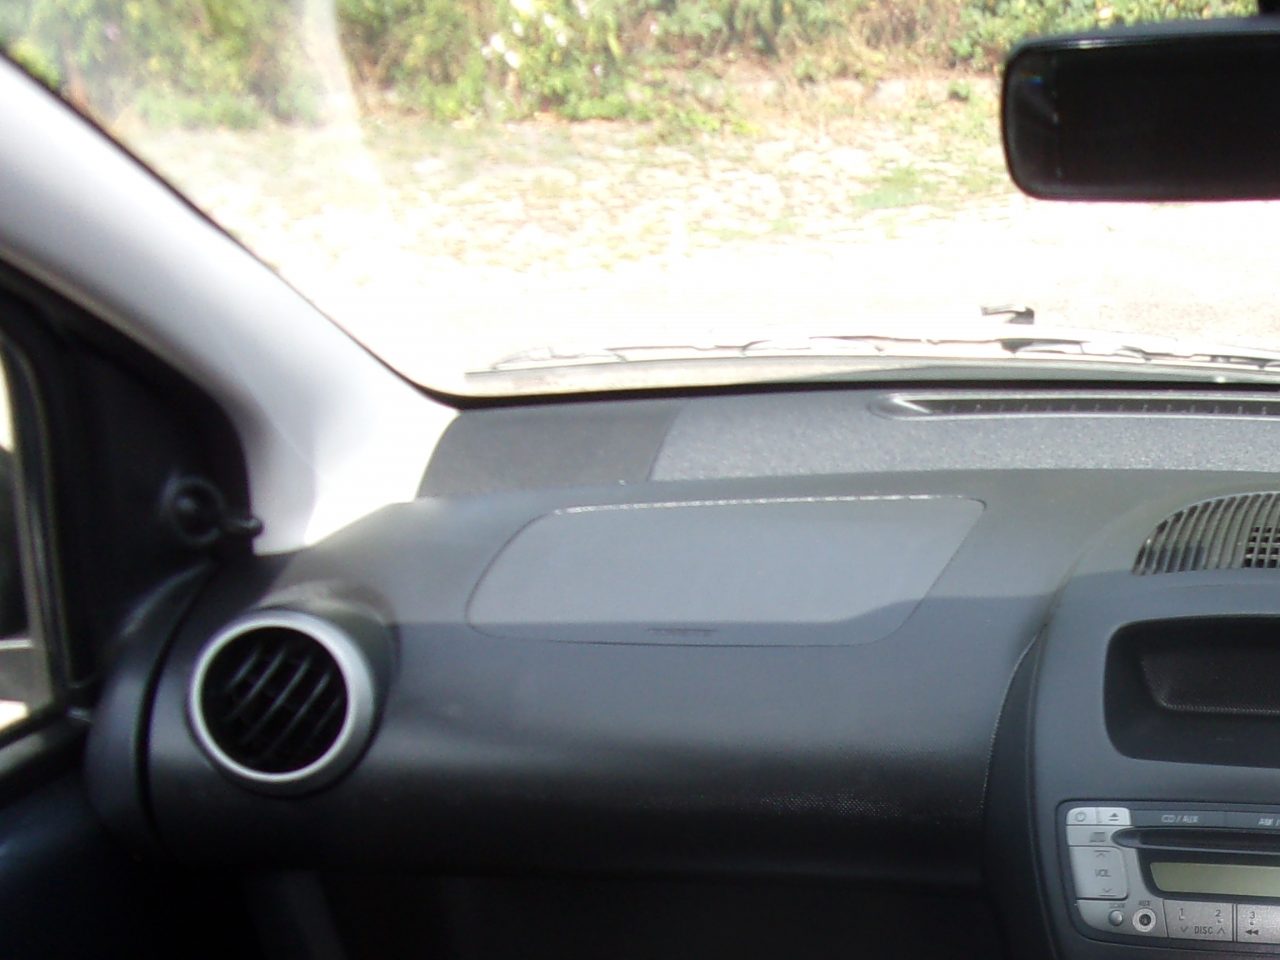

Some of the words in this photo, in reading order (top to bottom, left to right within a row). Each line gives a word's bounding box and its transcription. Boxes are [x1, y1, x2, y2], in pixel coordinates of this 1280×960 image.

[1094, 868, 1111, 878] VOL
[1215, 909, 1221, 917] 2
[1250, 911, 1256, 919] 3
[1194, 926, 1213, 935] DISC
